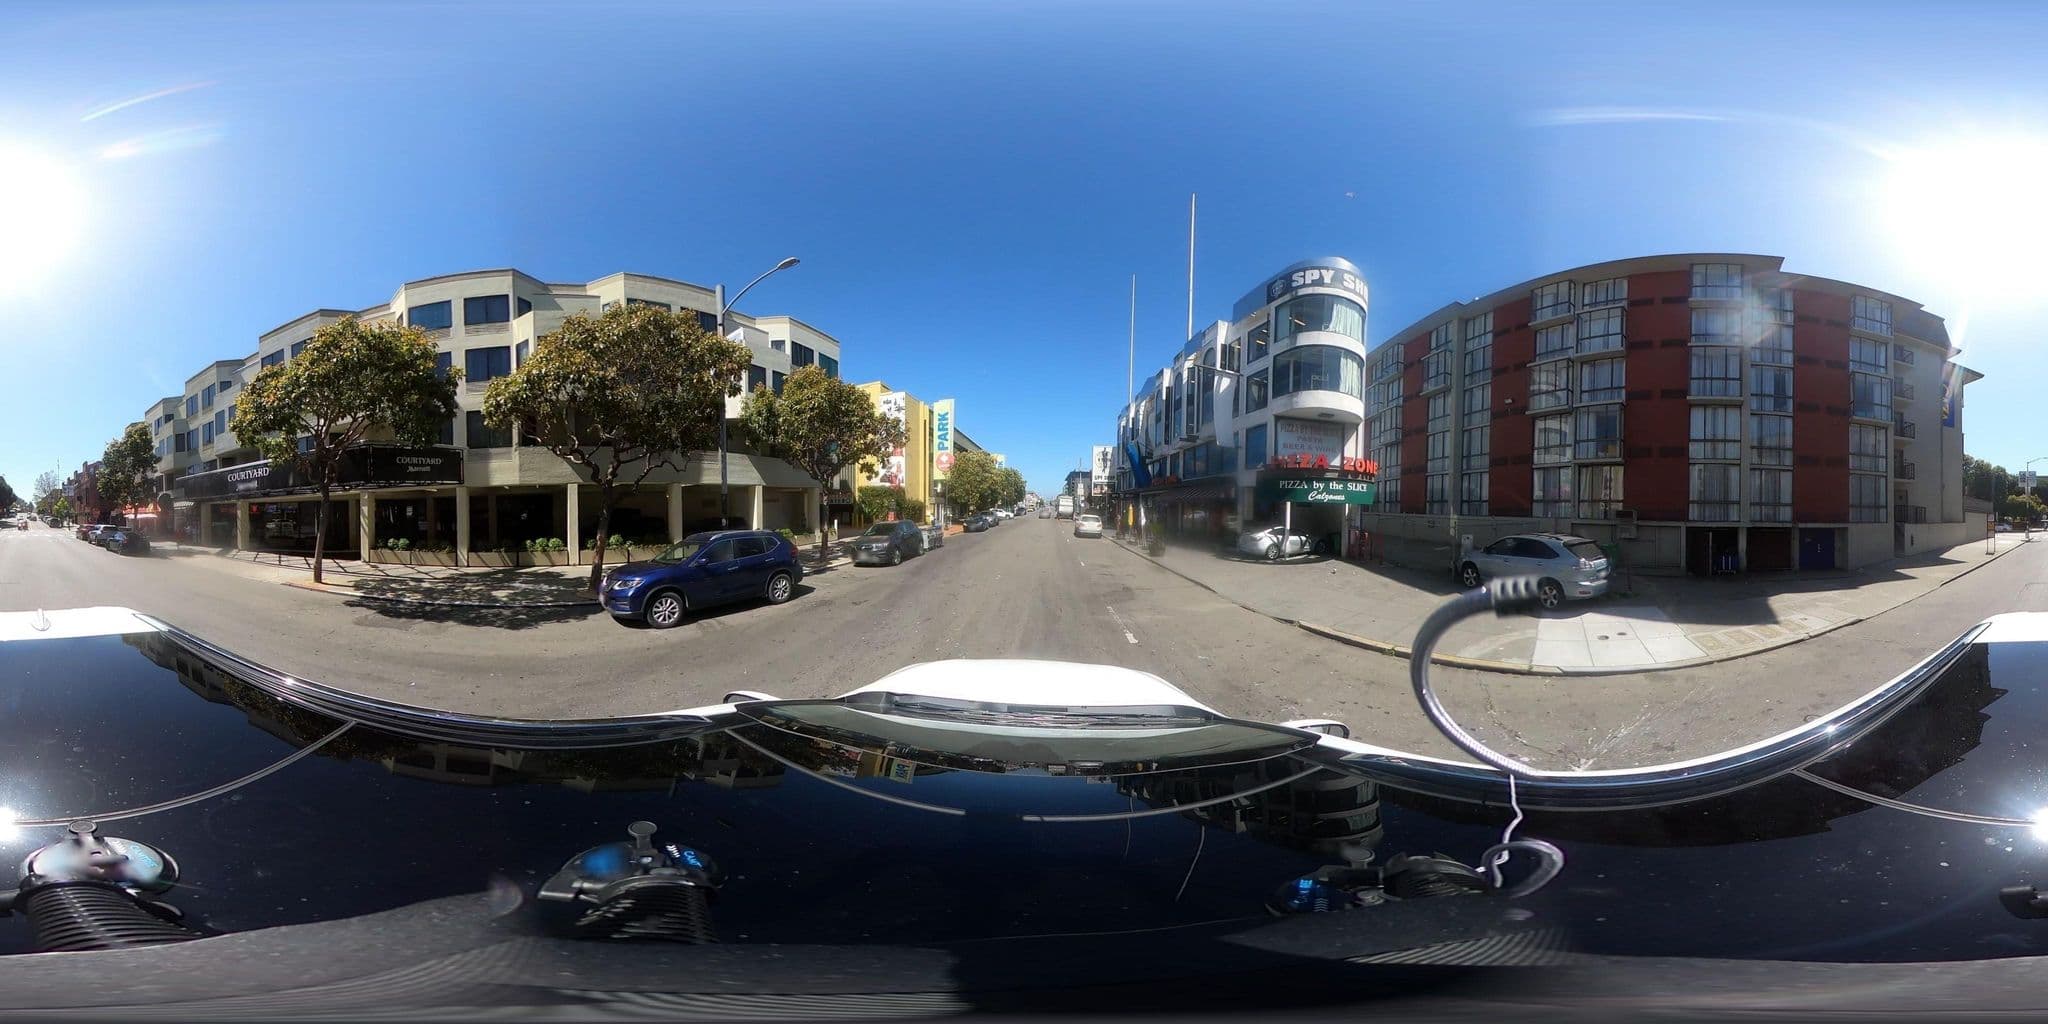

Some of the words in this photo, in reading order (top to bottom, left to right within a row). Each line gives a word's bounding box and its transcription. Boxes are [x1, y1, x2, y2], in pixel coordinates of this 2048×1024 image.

[1291, 269, 1335, 287] SPY
[938, 412, 949, 450] PARK
[396, 456, 442, 465] COURTYARD
[228, 468, 270, 482] COURTYARD
[1280, 481, 1308, 489] PIZZA
[1313, 481, 1325, 491] by
[1329, 482, 1344, 490] the
[1347, 482, 1367, 492] SLICE
